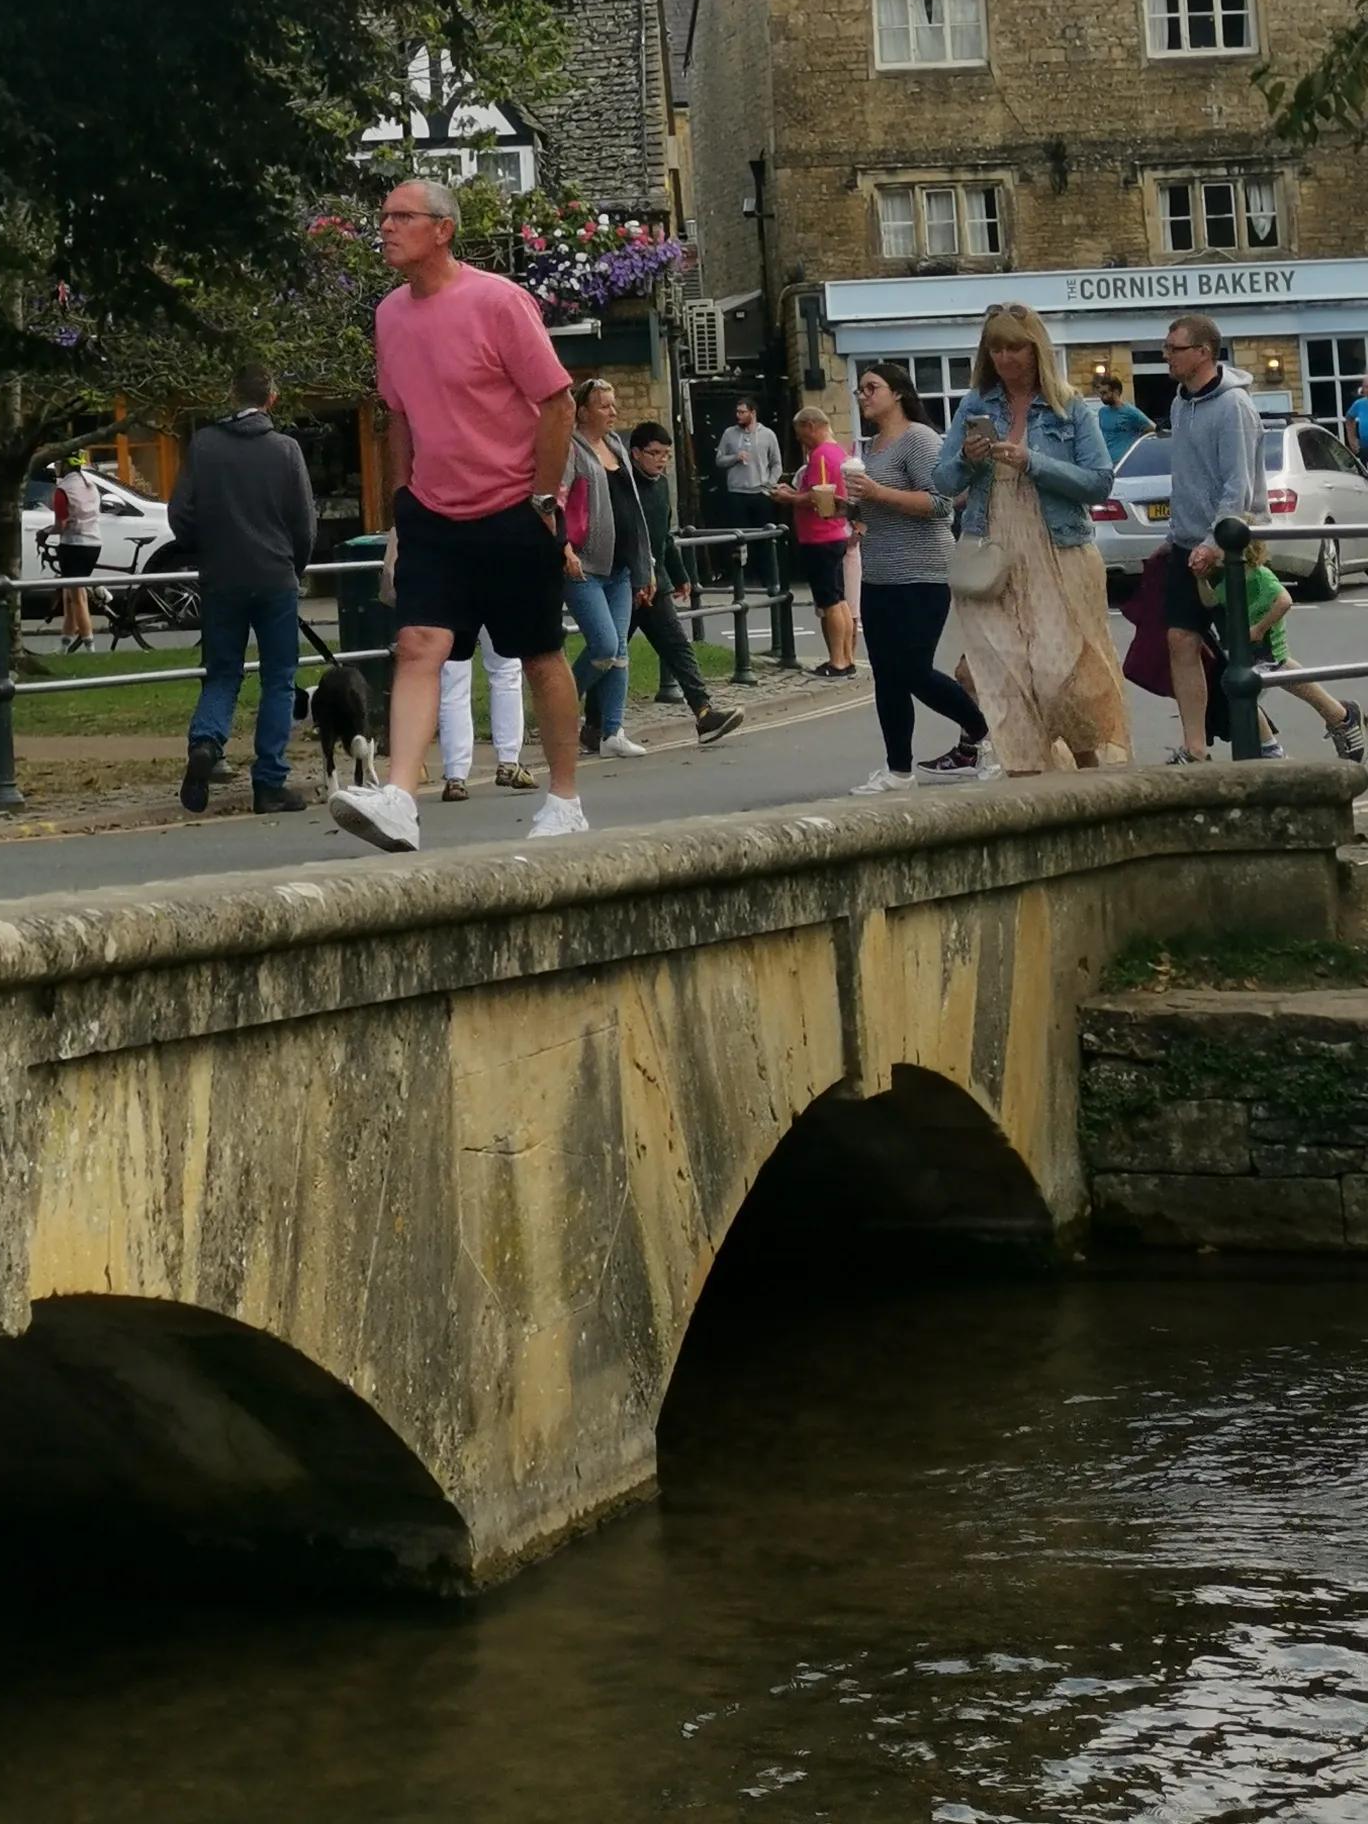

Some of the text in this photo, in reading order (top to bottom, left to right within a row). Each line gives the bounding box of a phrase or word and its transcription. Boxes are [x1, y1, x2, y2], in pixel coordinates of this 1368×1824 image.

[1067, 270, 1296, 301] THE CORNISH BAKERY
